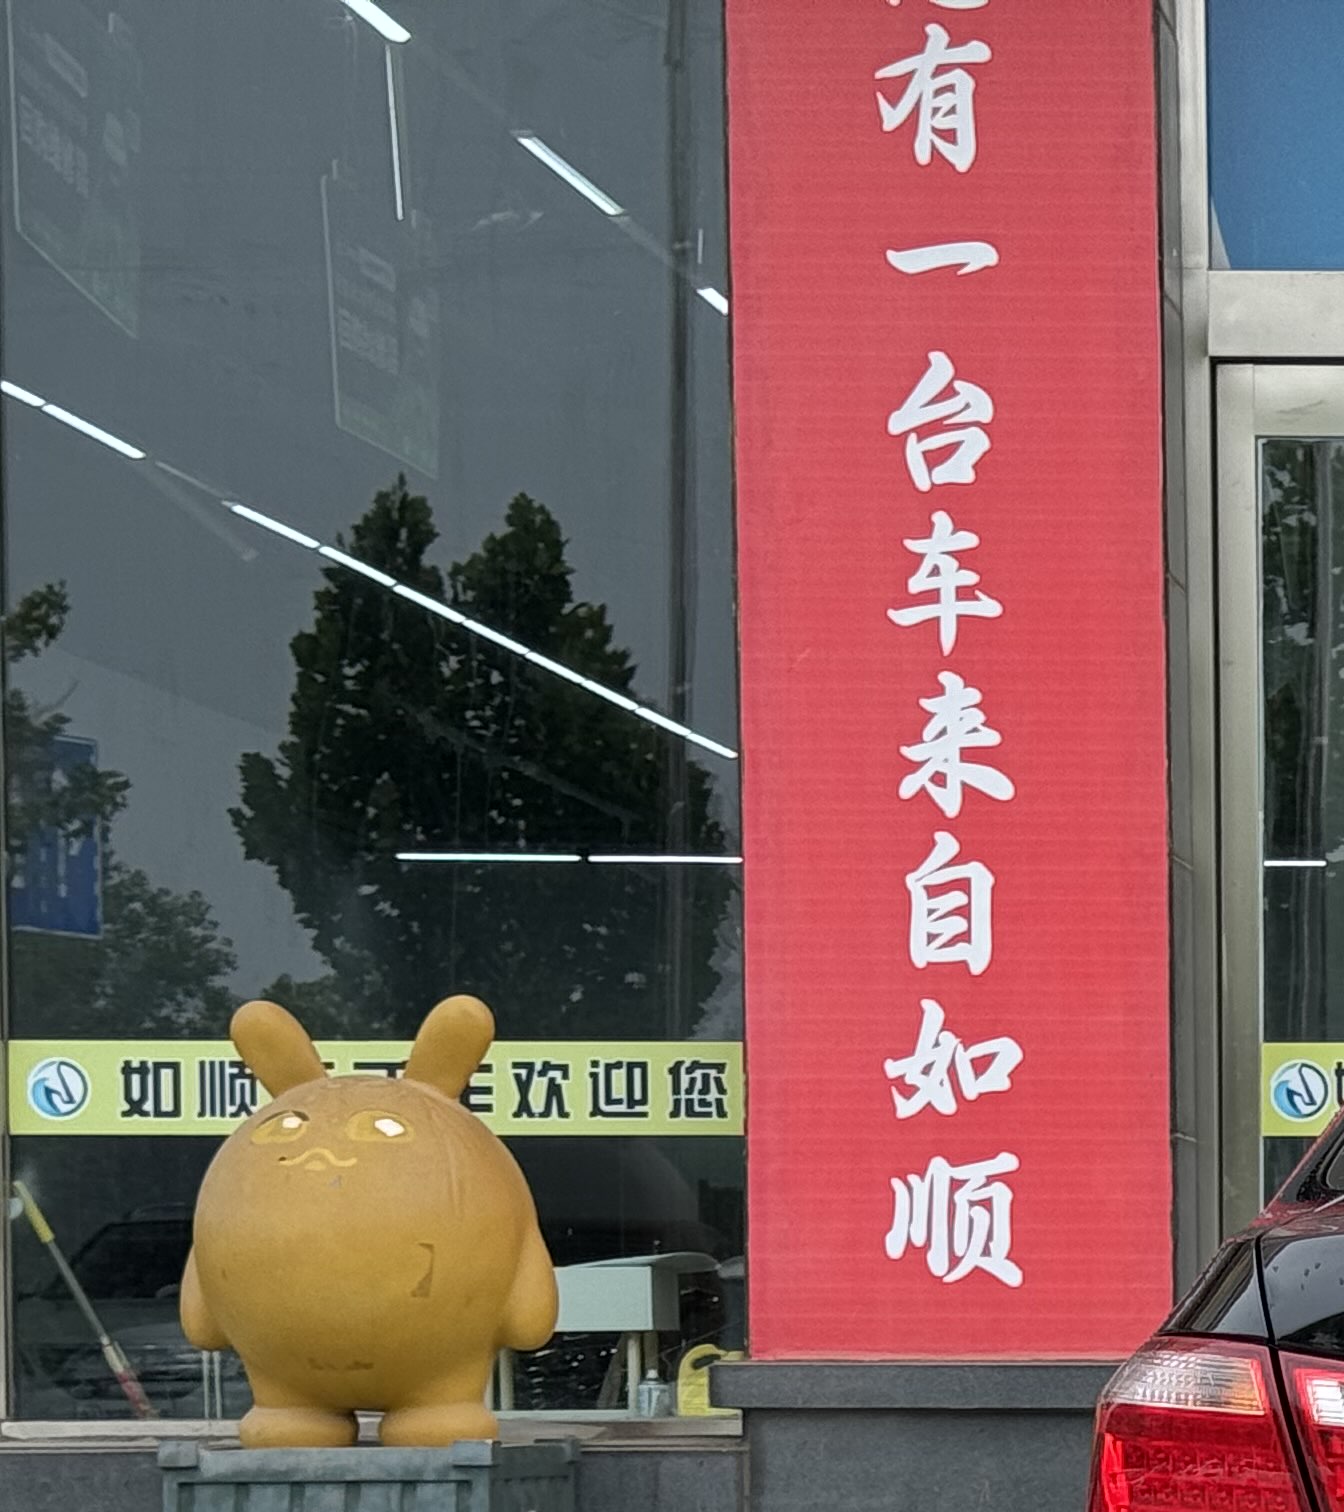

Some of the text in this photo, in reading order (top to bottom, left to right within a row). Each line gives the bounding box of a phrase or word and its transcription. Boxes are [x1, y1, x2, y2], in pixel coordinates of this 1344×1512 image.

[875, 0, 1023, 1288] 有一台车来自如顺
[120, 1059, 729, 1121] 如顺欢迎您
